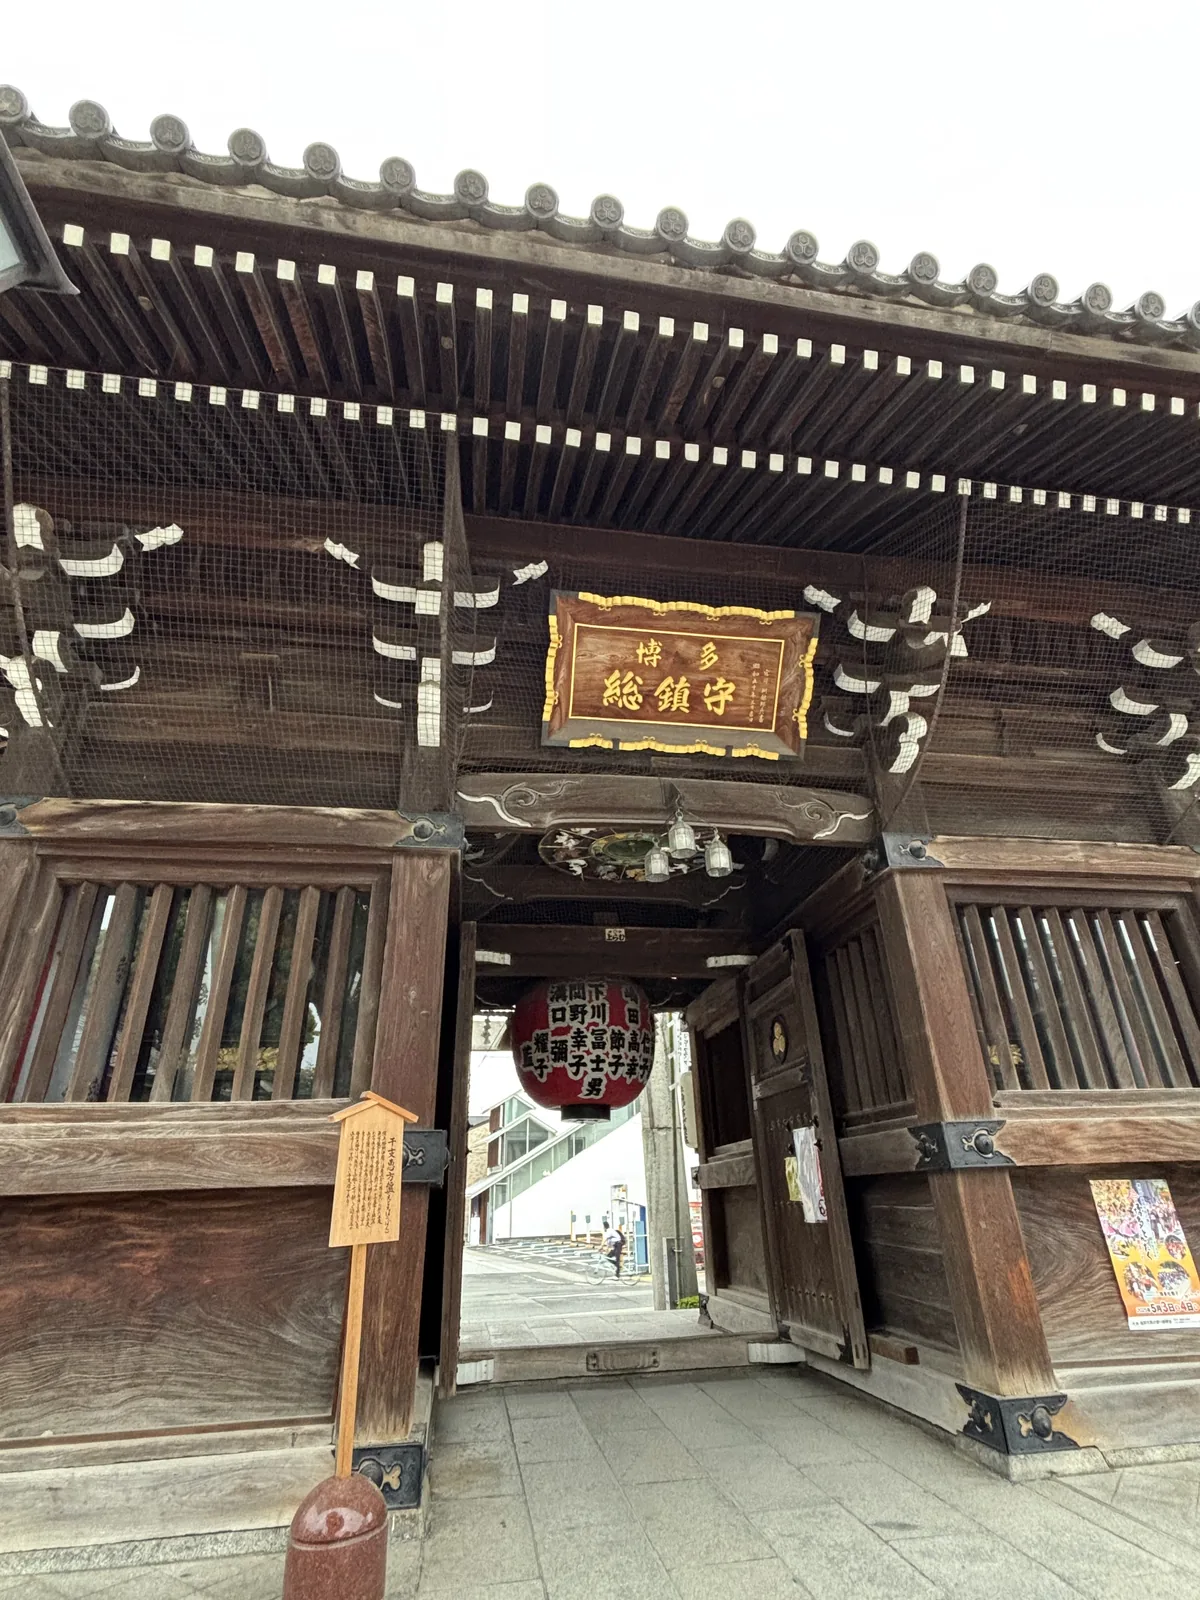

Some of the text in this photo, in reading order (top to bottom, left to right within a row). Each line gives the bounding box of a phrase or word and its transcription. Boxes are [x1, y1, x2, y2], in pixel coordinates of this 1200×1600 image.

[636, 638, 719, 670] 博多
[602, 669, 737, 716] 総鎮守
[608, 1029, 625, 1076] 節子
